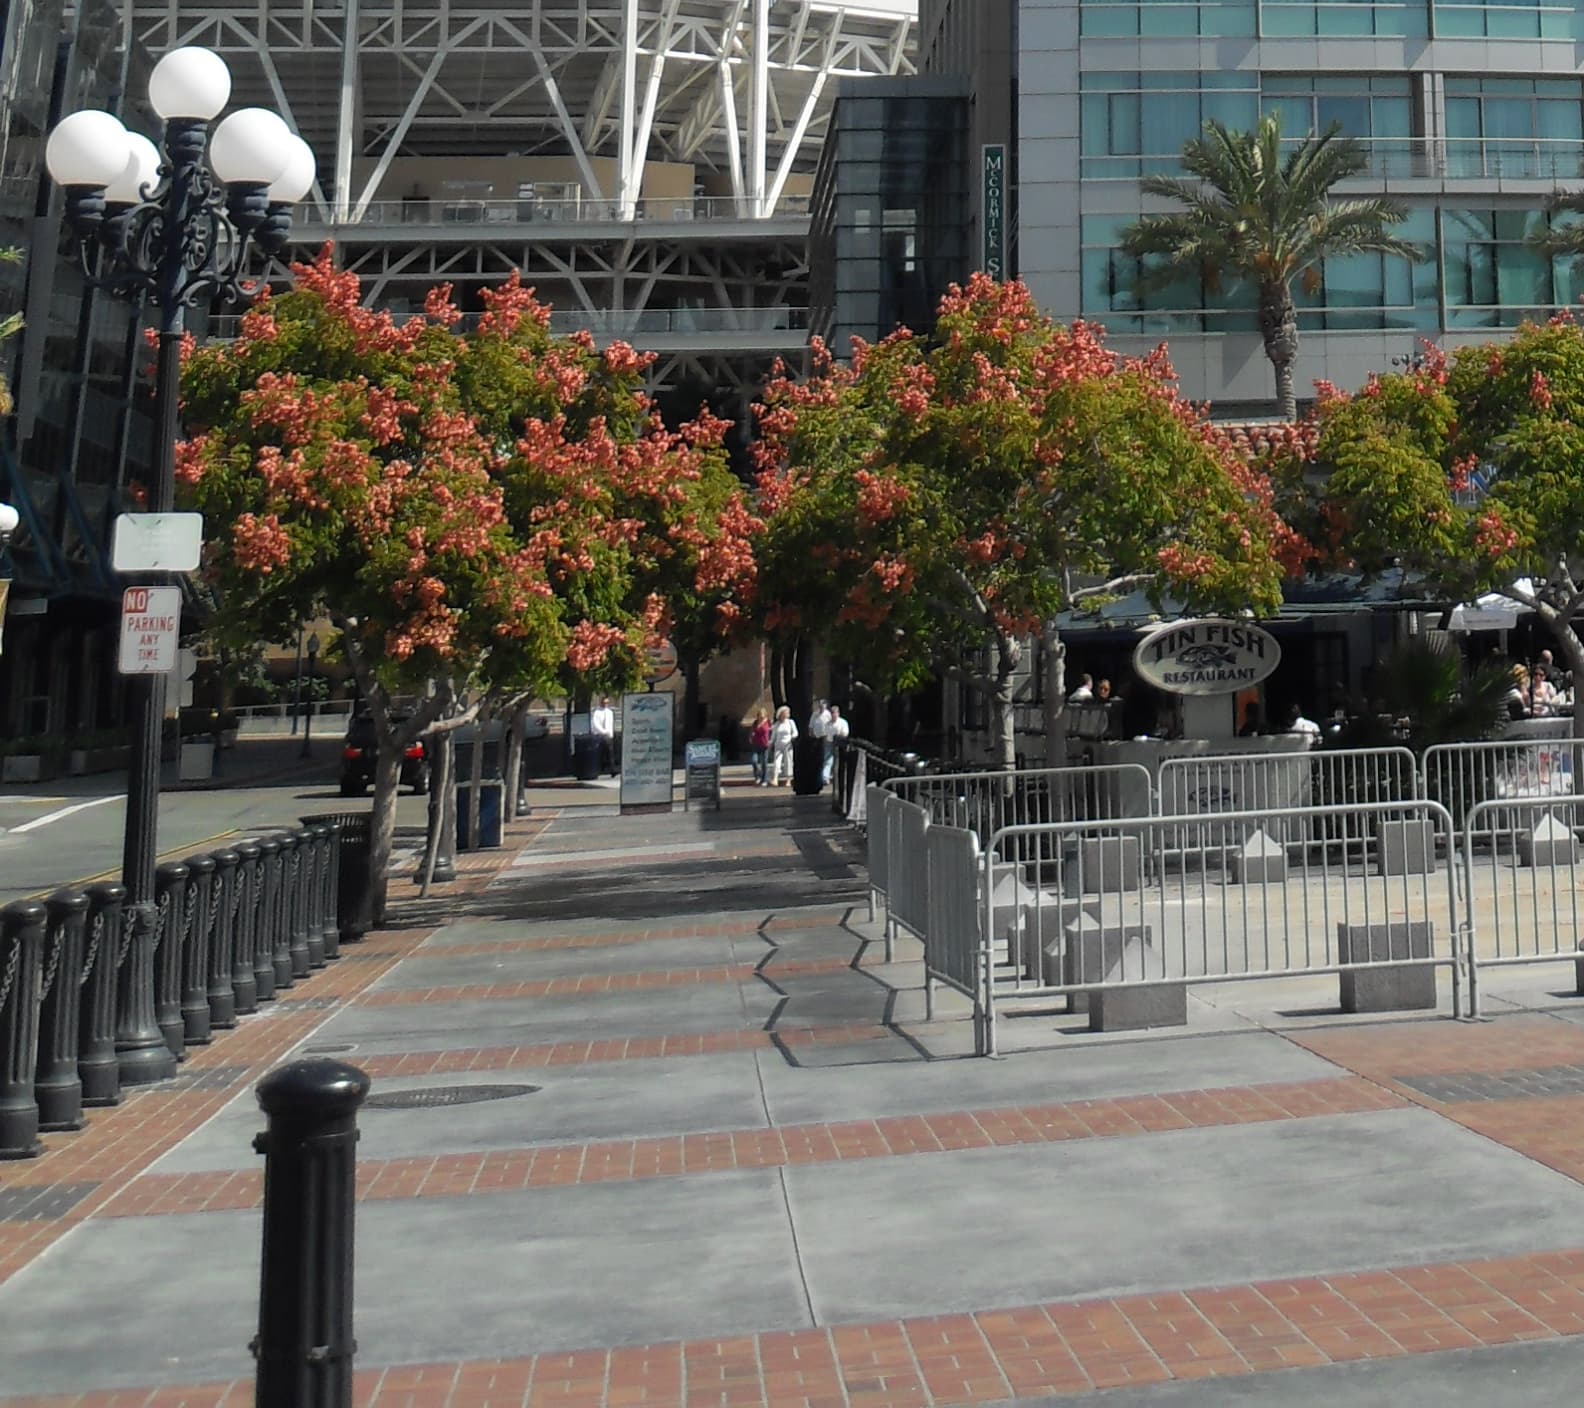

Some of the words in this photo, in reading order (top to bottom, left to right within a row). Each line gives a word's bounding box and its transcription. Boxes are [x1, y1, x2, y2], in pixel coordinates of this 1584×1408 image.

[126, 591, 147, 610] NO
[127, 616, 175, 632] PARKING
[139, 634, 160, 646] ANY
[1151, 627, 1196, 664] TIN
[1206, 626, 1265, 659] FISH
[137, 648, 160, 661] TIME
[1163, 668, 1257, 684] RESTAURANT
